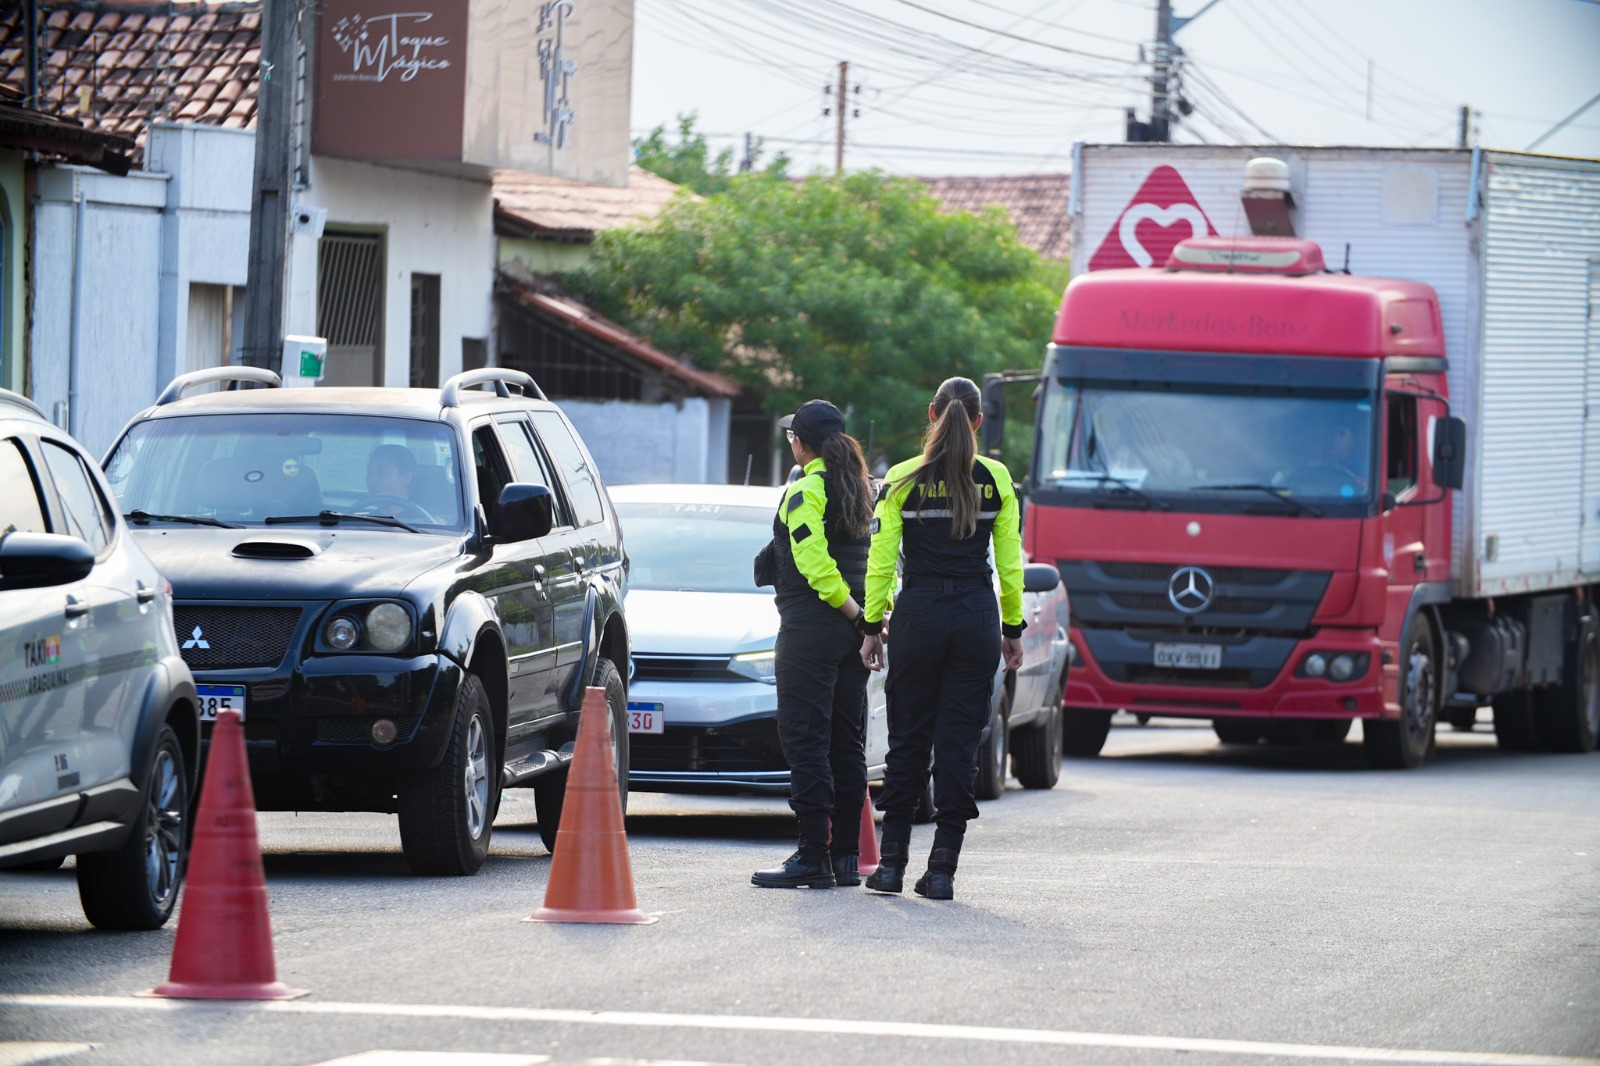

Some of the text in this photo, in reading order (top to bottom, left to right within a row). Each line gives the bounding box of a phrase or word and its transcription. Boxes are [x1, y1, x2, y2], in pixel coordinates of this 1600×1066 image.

[365, 12, 449, 59] Toque
[1120, 308, 1309, 338] Mercedes-Benz
[918, 480, 993, 499] TRÂTO
[672, 503, 720, 513] TAXI
[627, 712, 653, 730] 30
